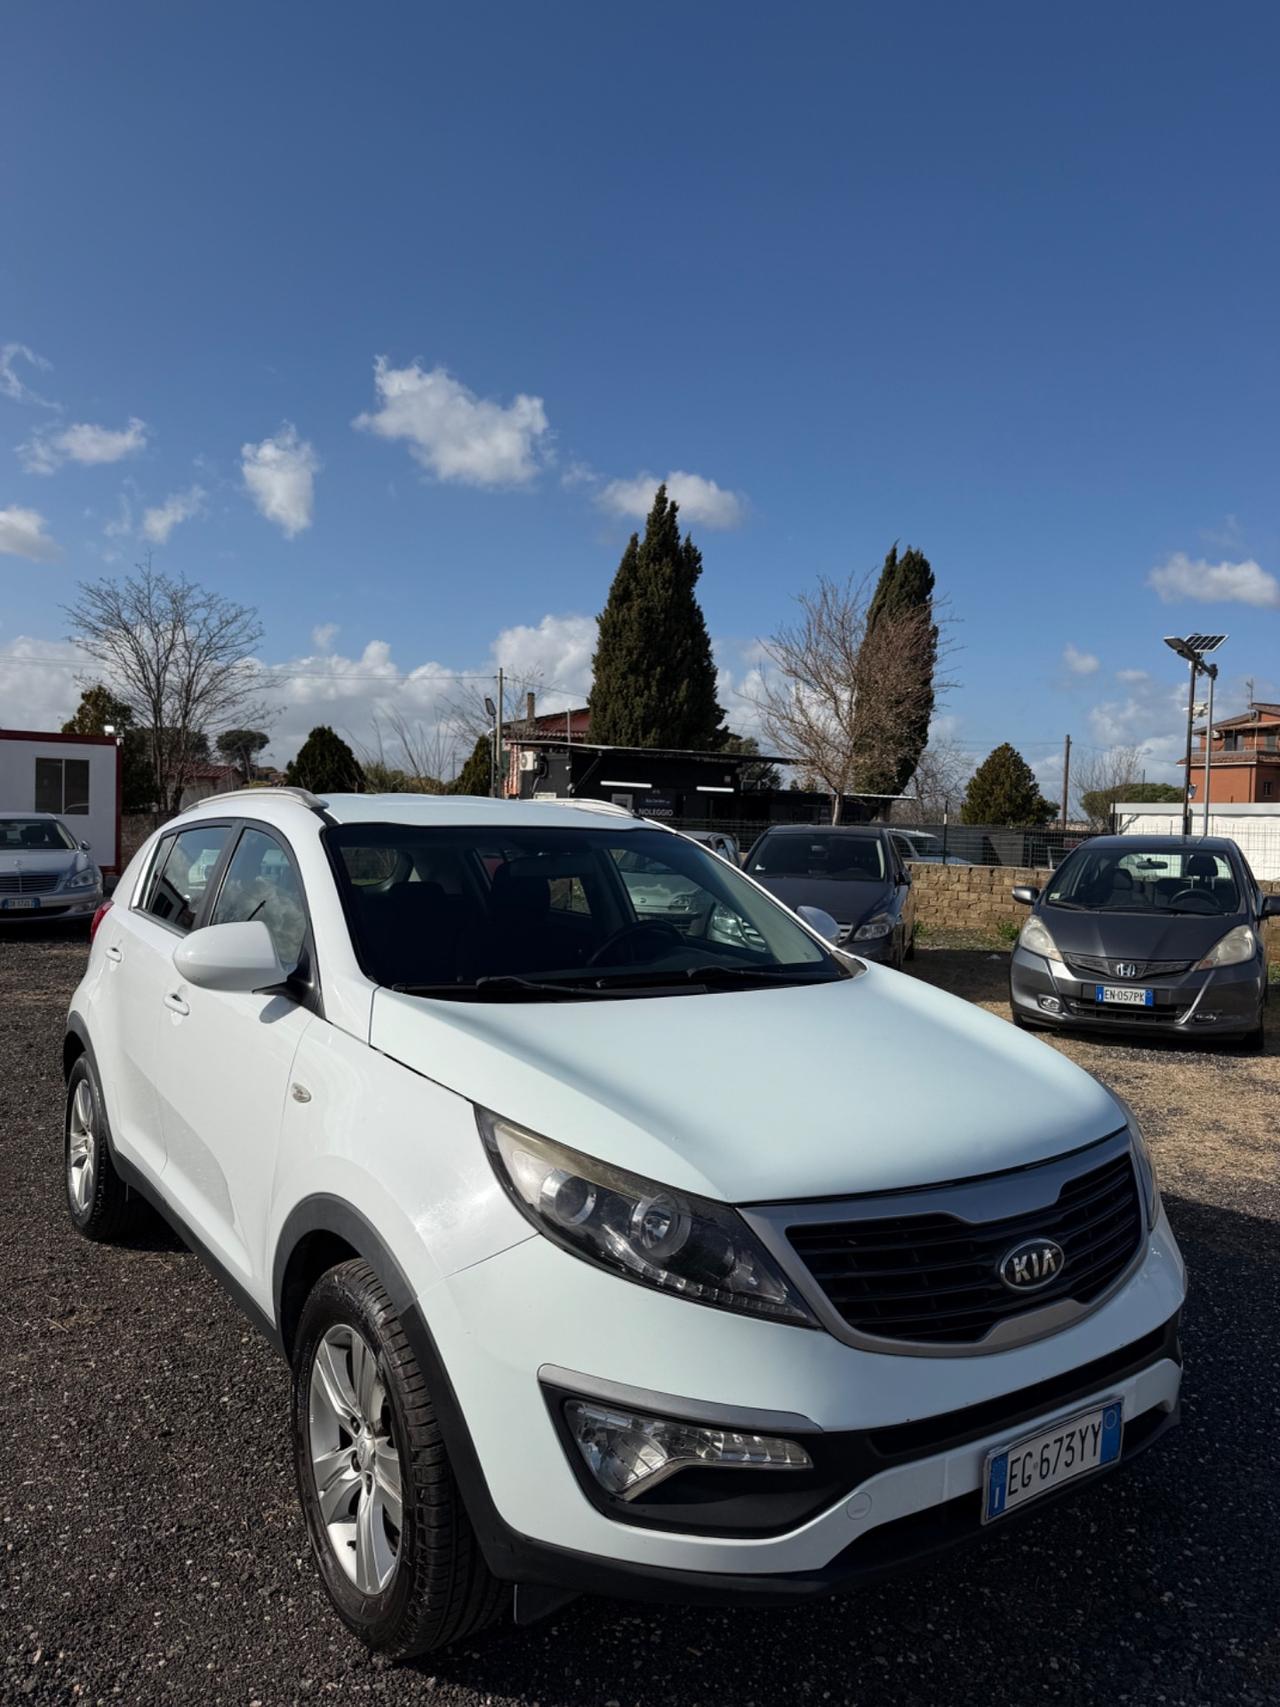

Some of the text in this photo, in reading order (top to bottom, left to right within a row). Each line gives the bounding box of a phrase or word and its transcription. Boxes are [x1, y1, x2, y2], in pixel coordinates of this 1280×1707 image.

[639, 807, 674, 817] NOLEGGIO
[1012, 1248, 1058, 1283] KIA
[1007, 1451, 1033, 1497] EG
[1039, 1421, 1102, 1480] 673YY
